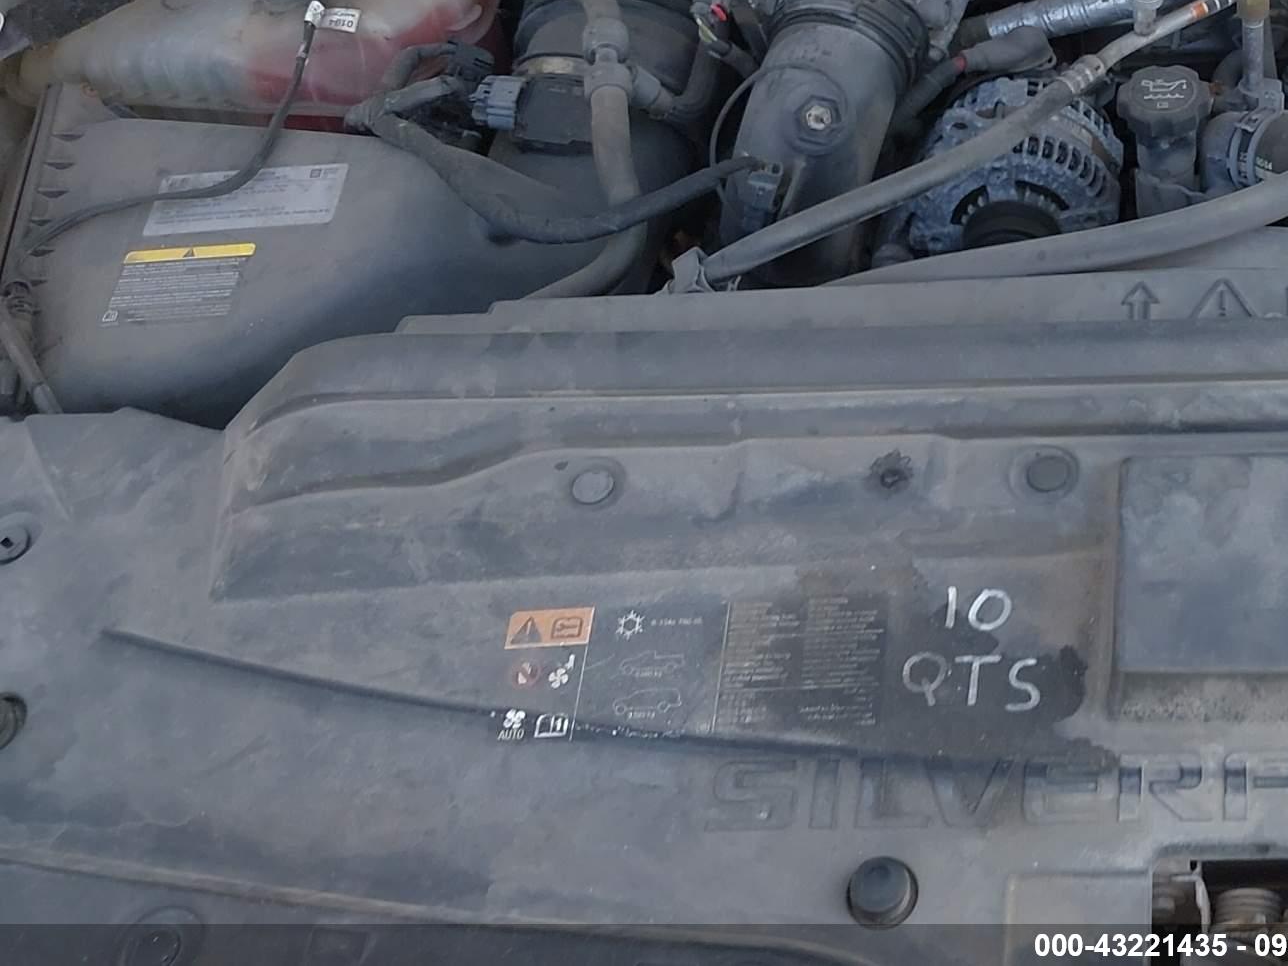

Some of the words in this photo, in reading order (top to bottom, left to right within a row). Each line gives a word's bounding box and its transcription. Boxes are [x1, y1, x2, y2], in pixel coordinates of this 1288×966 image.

[945, 586, 1012, 631] 10
[902, 652, 1041, 712] QTS
[498, 728, 525, 741] AUTO
